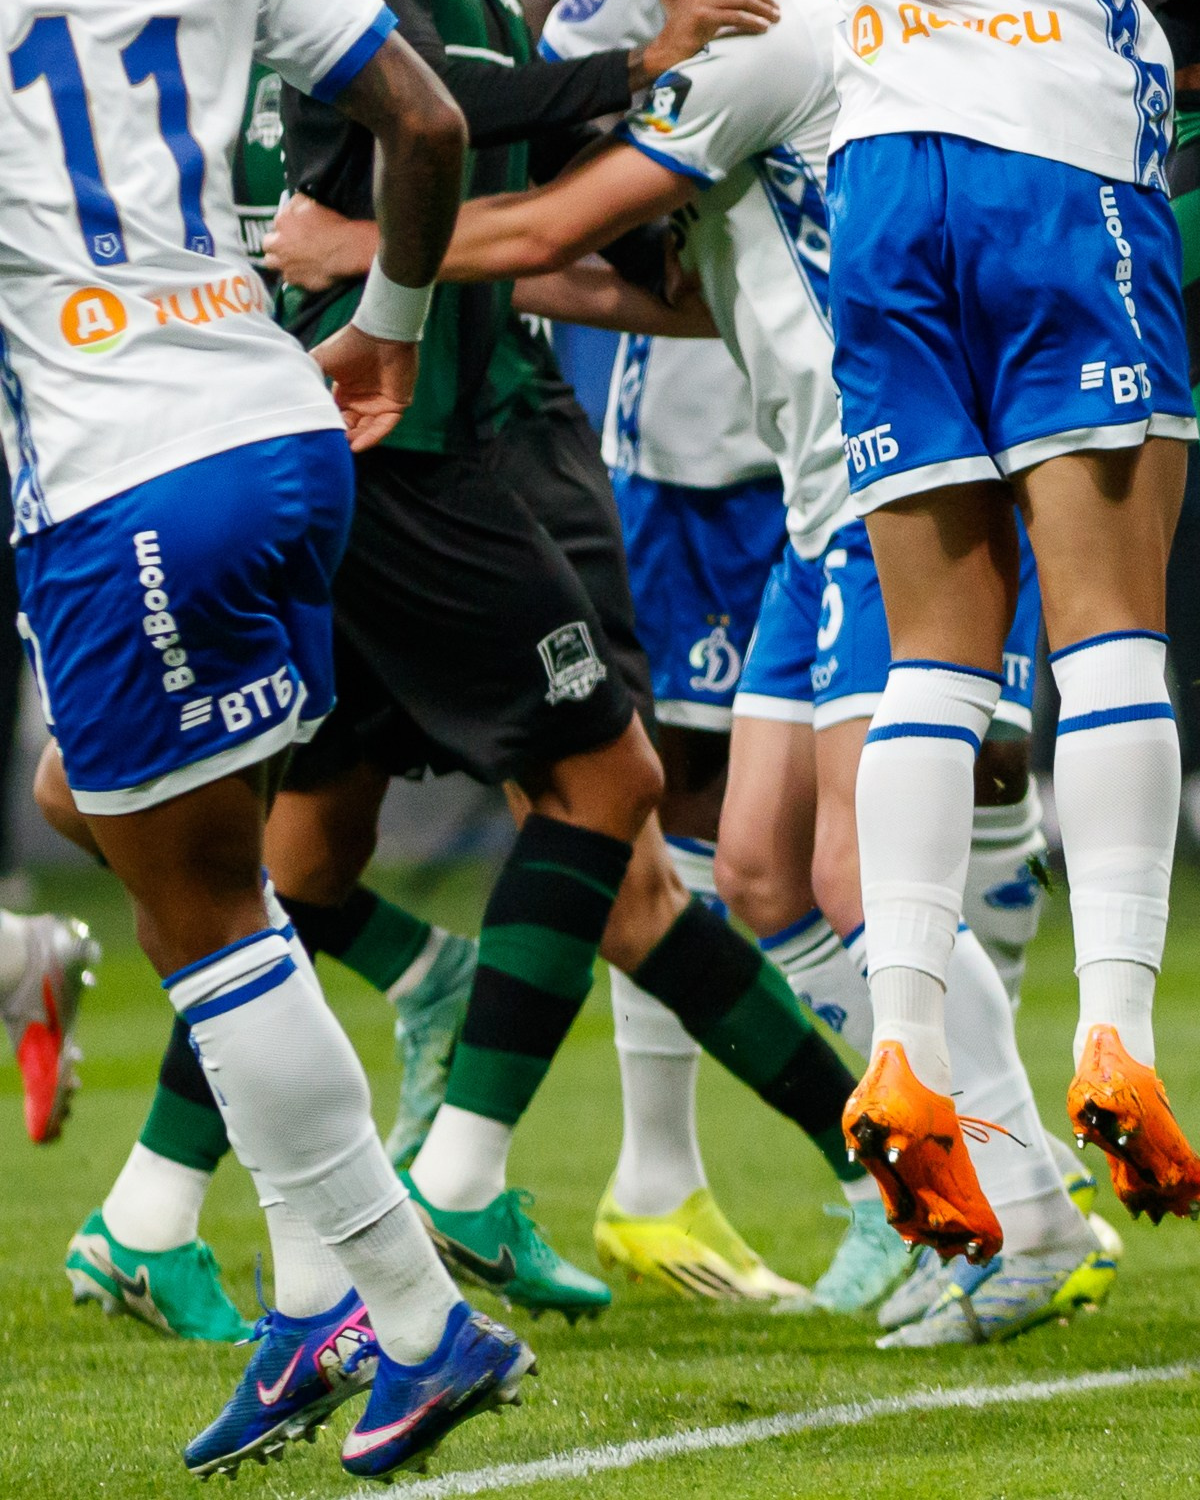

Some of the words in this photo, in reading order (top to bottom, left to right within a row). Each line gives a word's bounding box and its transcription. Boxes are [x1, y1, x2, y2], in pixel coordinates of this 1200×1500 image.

[9, 14, 216, 267] 11
[847, 423, 900, 474] ВТБ
[132, 529, 196, 694] BetBoom
[218, 664, 294, 734] ВТБ
